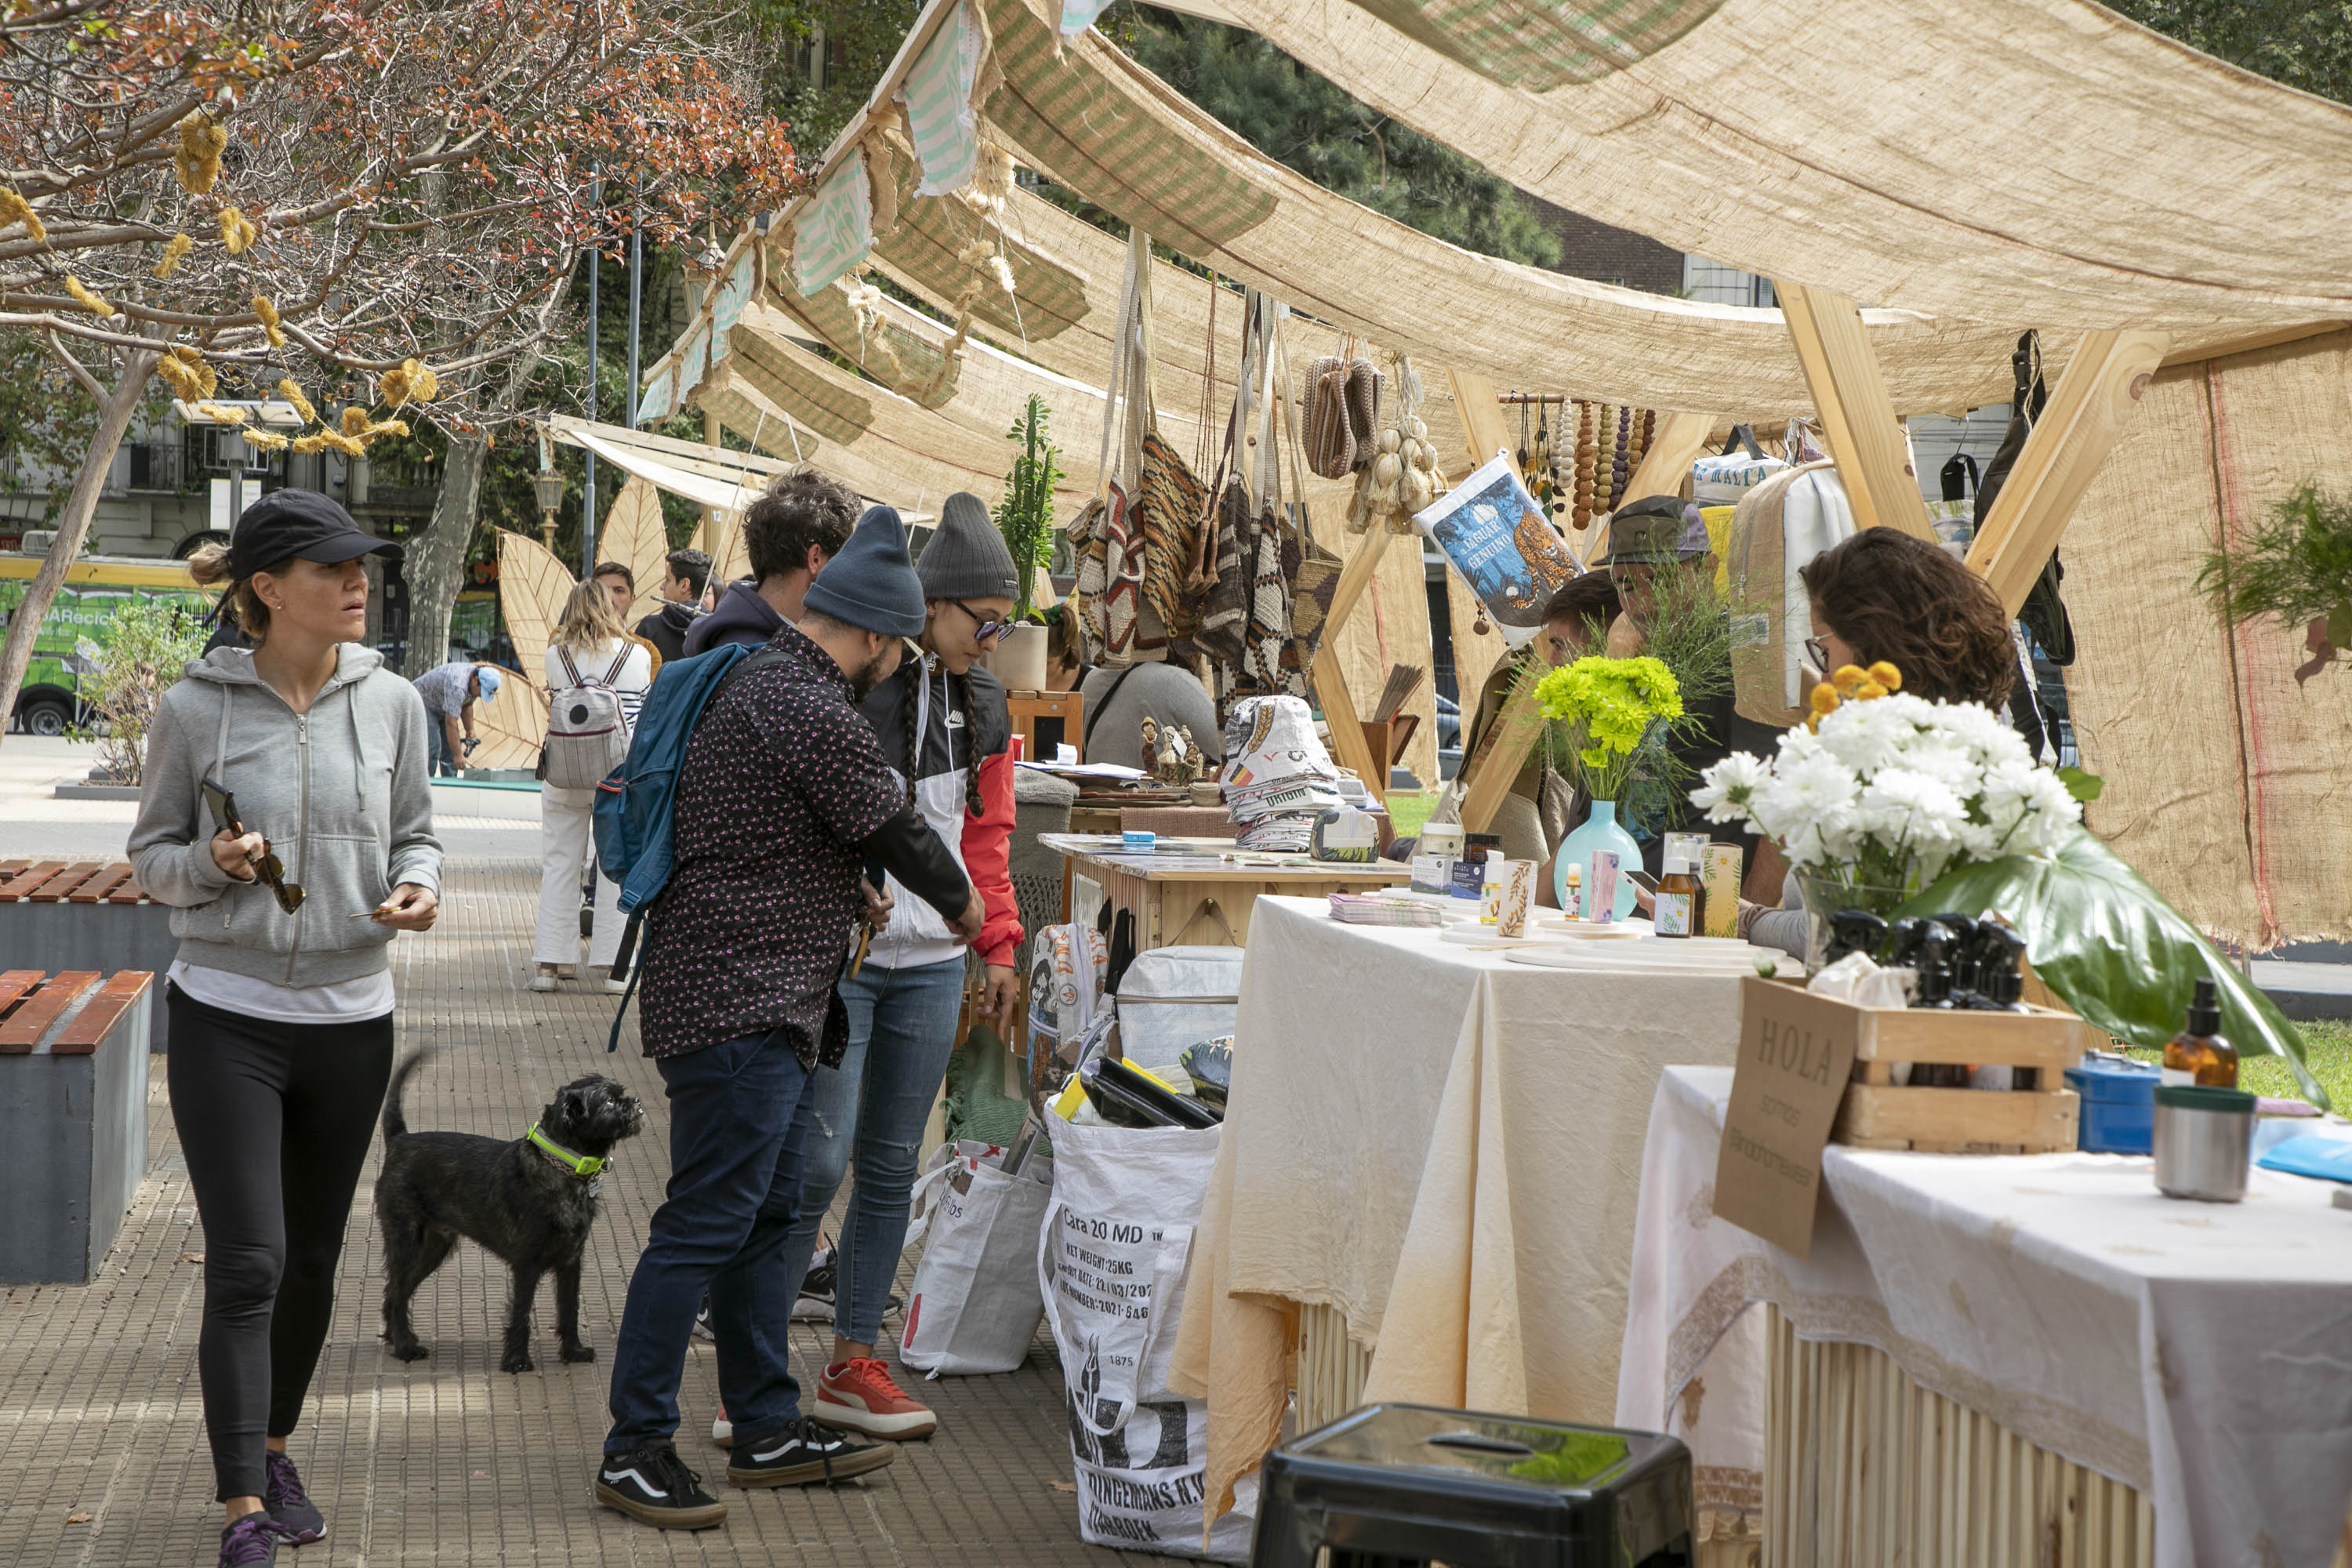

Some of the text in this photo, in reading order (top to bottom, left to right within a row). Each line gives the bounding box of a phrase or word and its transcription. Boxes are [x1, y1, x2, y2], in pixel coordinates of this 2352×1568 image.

[713, 510, 721, 522] 12
[1468, 533, 1512, 569] GENUINO
[44, 608, 116, 625] ARecicl
[949, 710, 965, 722] NIK
[1758, 1017, 1832, 1086] HOLA
[1064, 1208, 1087, 1235] Cara
[1091, 1219, 1107, 1240] 20
[1112, 1224, 1143, 1243] MD
[1110, 1355, 1133, 1367] 1875
